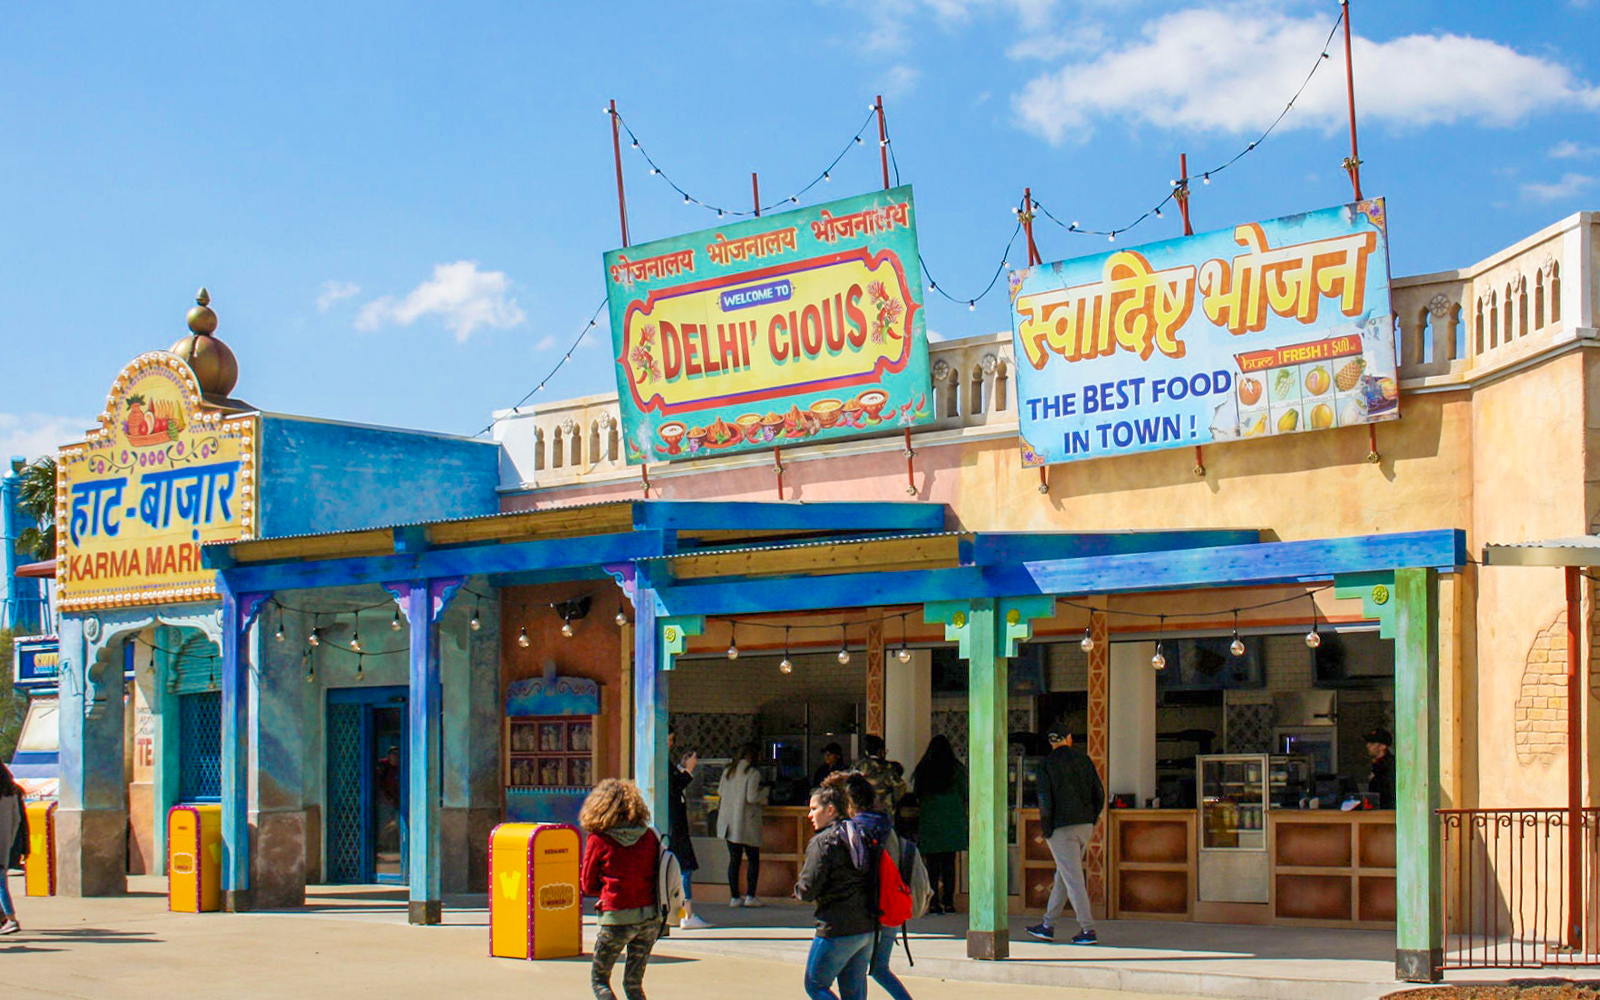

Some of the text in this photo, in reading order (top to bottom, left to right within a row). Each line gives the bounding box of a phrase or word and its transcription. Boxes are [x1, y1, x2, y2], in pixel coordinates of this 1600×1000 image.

[609, 249, 695, 285] भोजनालय
[707, 226, 797, 266] भोजनालय
[723, 284, 789, 308] WELCOME TO
[1199, 222, 1377, 334] भोजन
[768, 284, 868, 363] CIOUS
[1027, 369, 1231, 421] THE BEST FOOD
[1064, 429, 1090, 455] IN
[1096, 414, 1181, 448] TOWN
[69, 539, 237, 582] KARMA MARK
[137, 737, 155, 767] TE
[499, 870, 522, 901] W
